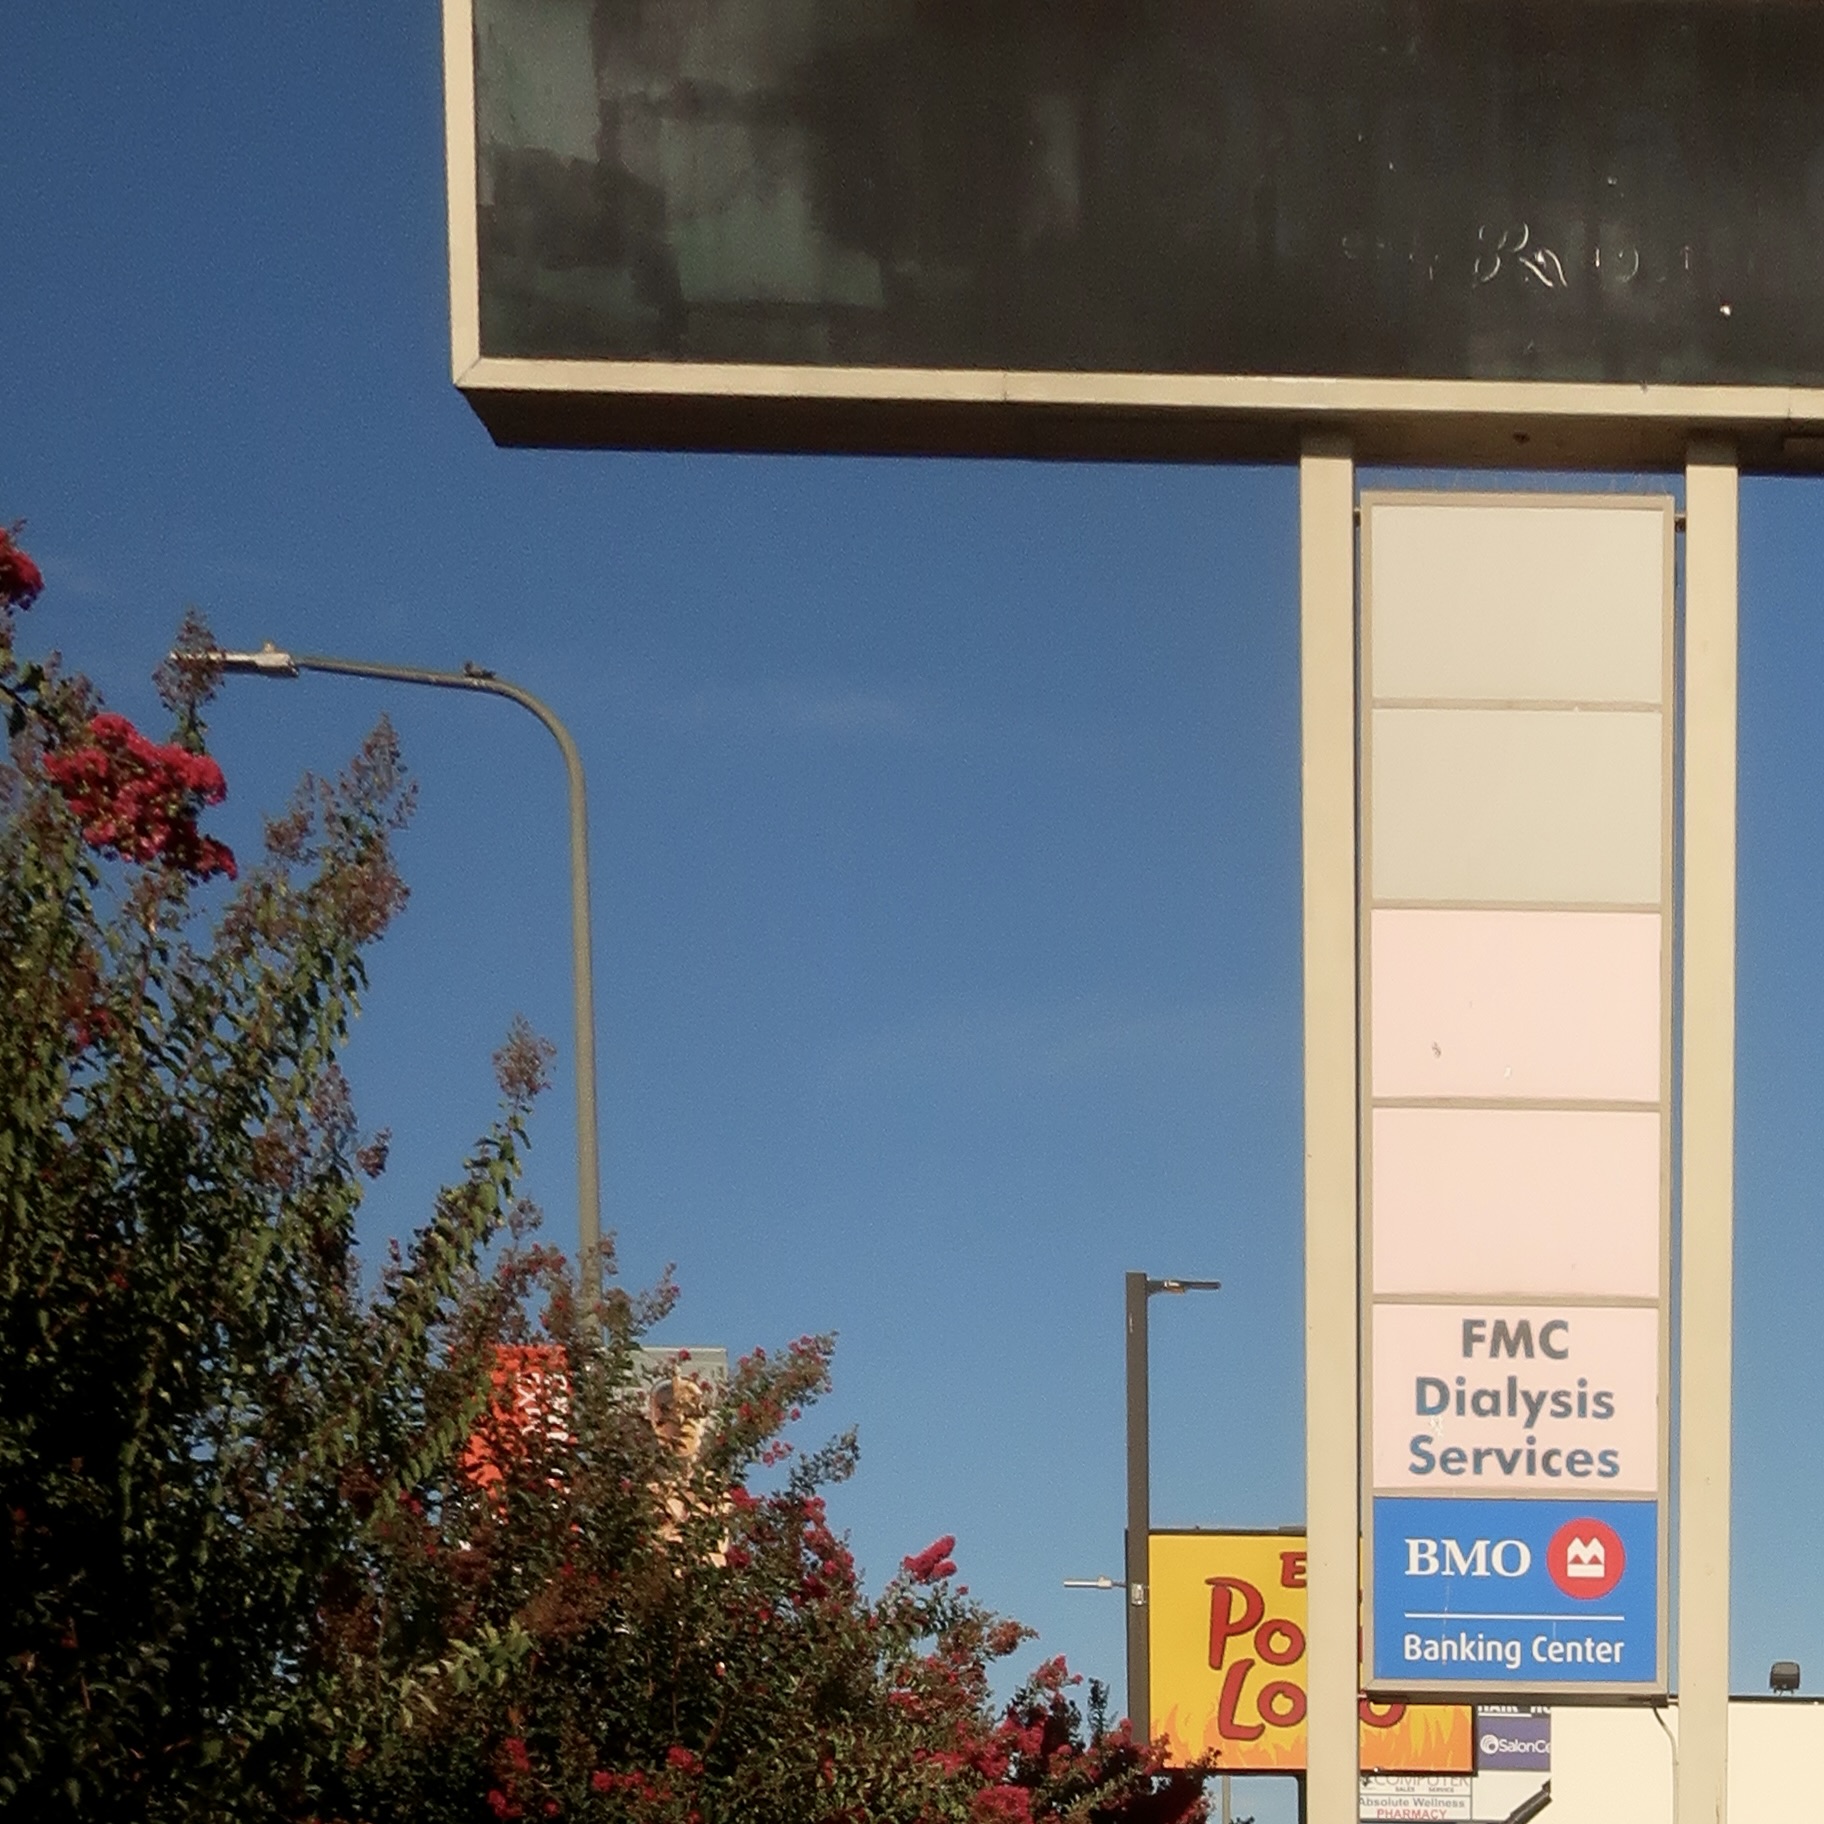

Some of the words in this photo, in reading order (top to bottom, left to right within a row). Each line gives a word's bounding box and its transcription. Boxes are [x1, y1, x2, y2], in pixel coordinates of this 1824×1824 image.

[1462, 1318, 1570, 1360] FMC
[1415, 1375, 1616, 1429] Dialysis
[1408, 1433, 1621, 1478] Services
[1279, 1551, 1308, 1589] E
[1404, 1538, 1532, 1578] BMO
[1404, 1631, 1522, 1670] Banking
[1531, 1635, 1625, 1664] Center
[1358, 1797, 1410, 1808] Absolute
[1413, 1797, 1465, 1809] Wellness
[1376, 1808, 1448, 1820] PHARMACY
